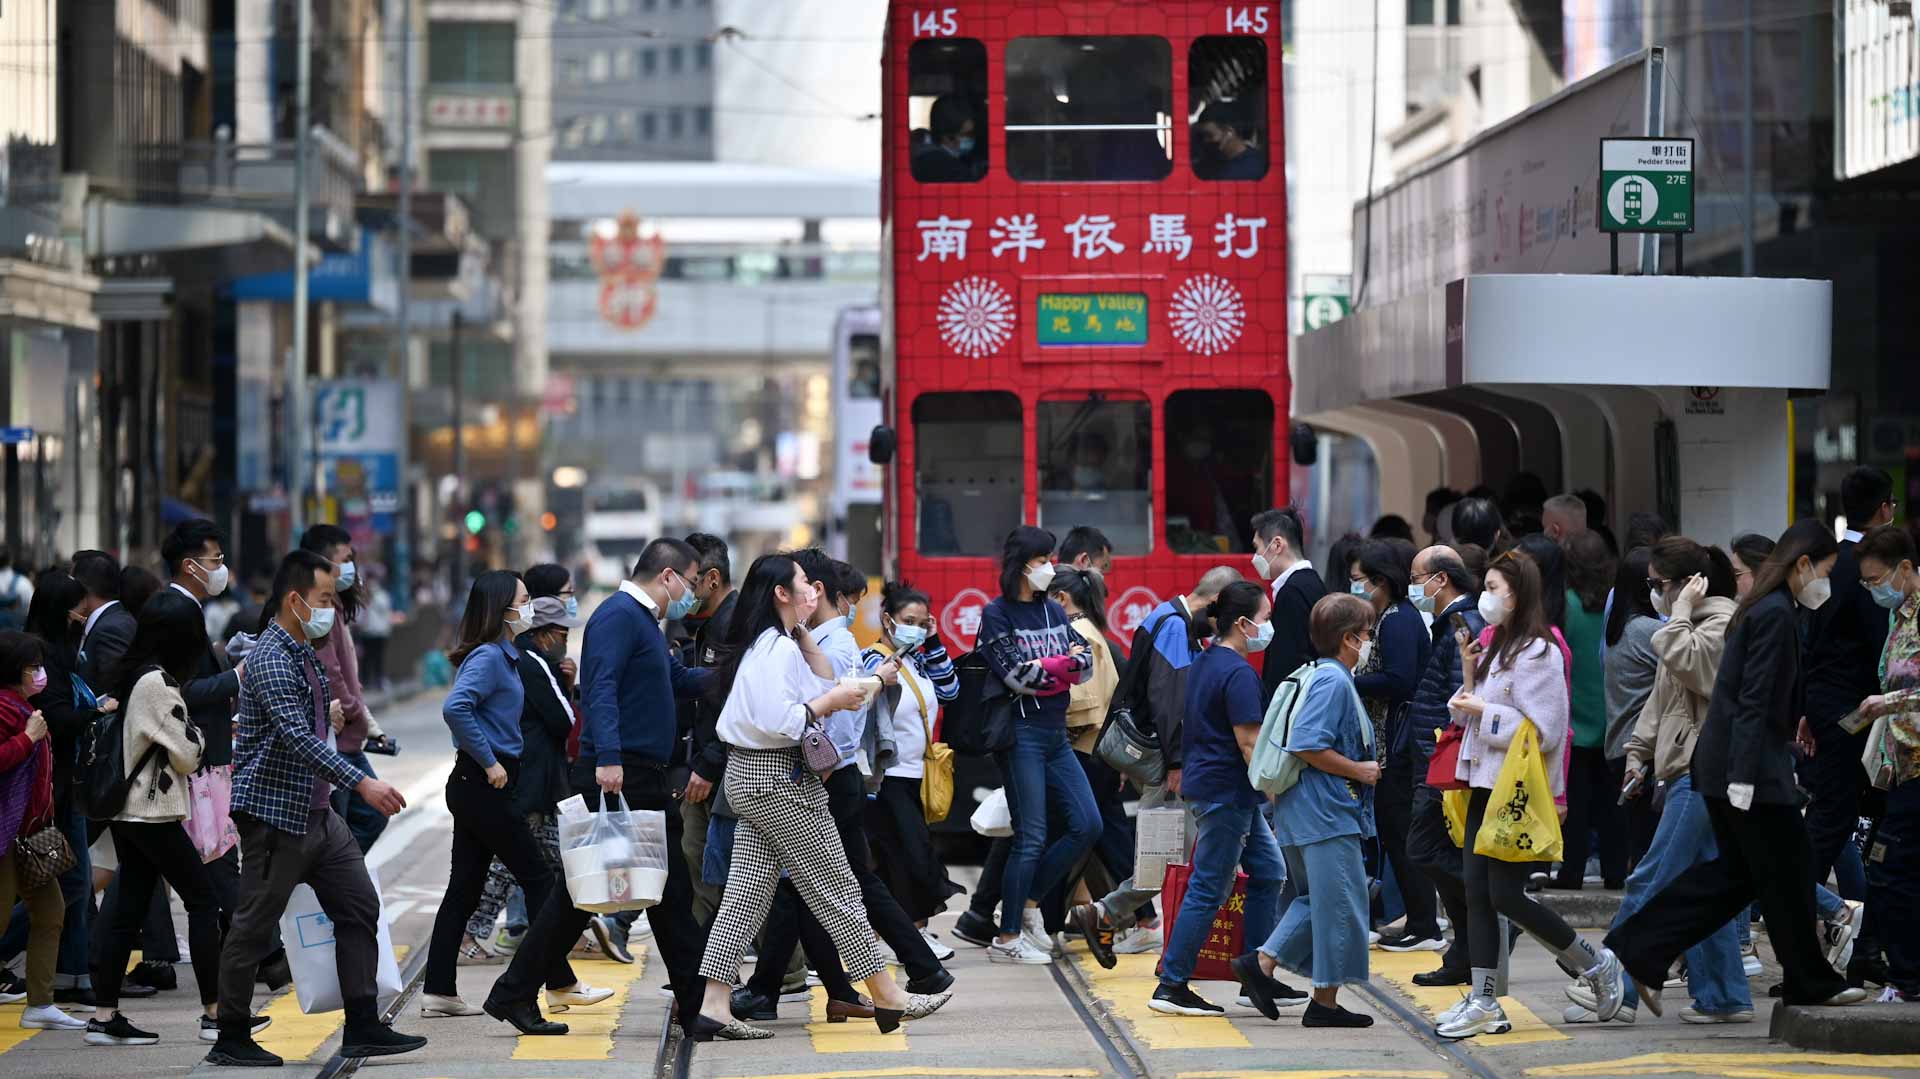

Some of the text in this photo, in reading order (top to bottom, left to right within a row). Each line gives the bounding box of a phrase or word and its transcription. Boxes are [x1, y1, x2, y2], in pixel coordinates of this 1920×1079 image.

[913, 9, 958, 36] 145
[1225, 6, 1269, 33] 145
[1666, 175, 1687, 185] 27E
[916, 213, 1267, 263] 南洋依馬打
[1041, 294, 1144, 313] Happy Valley
[1052, 314, 1136, 334] 跑馬地
[954, 605, 982, 635] 香
[1482, 975, 1496, 997] 1977
